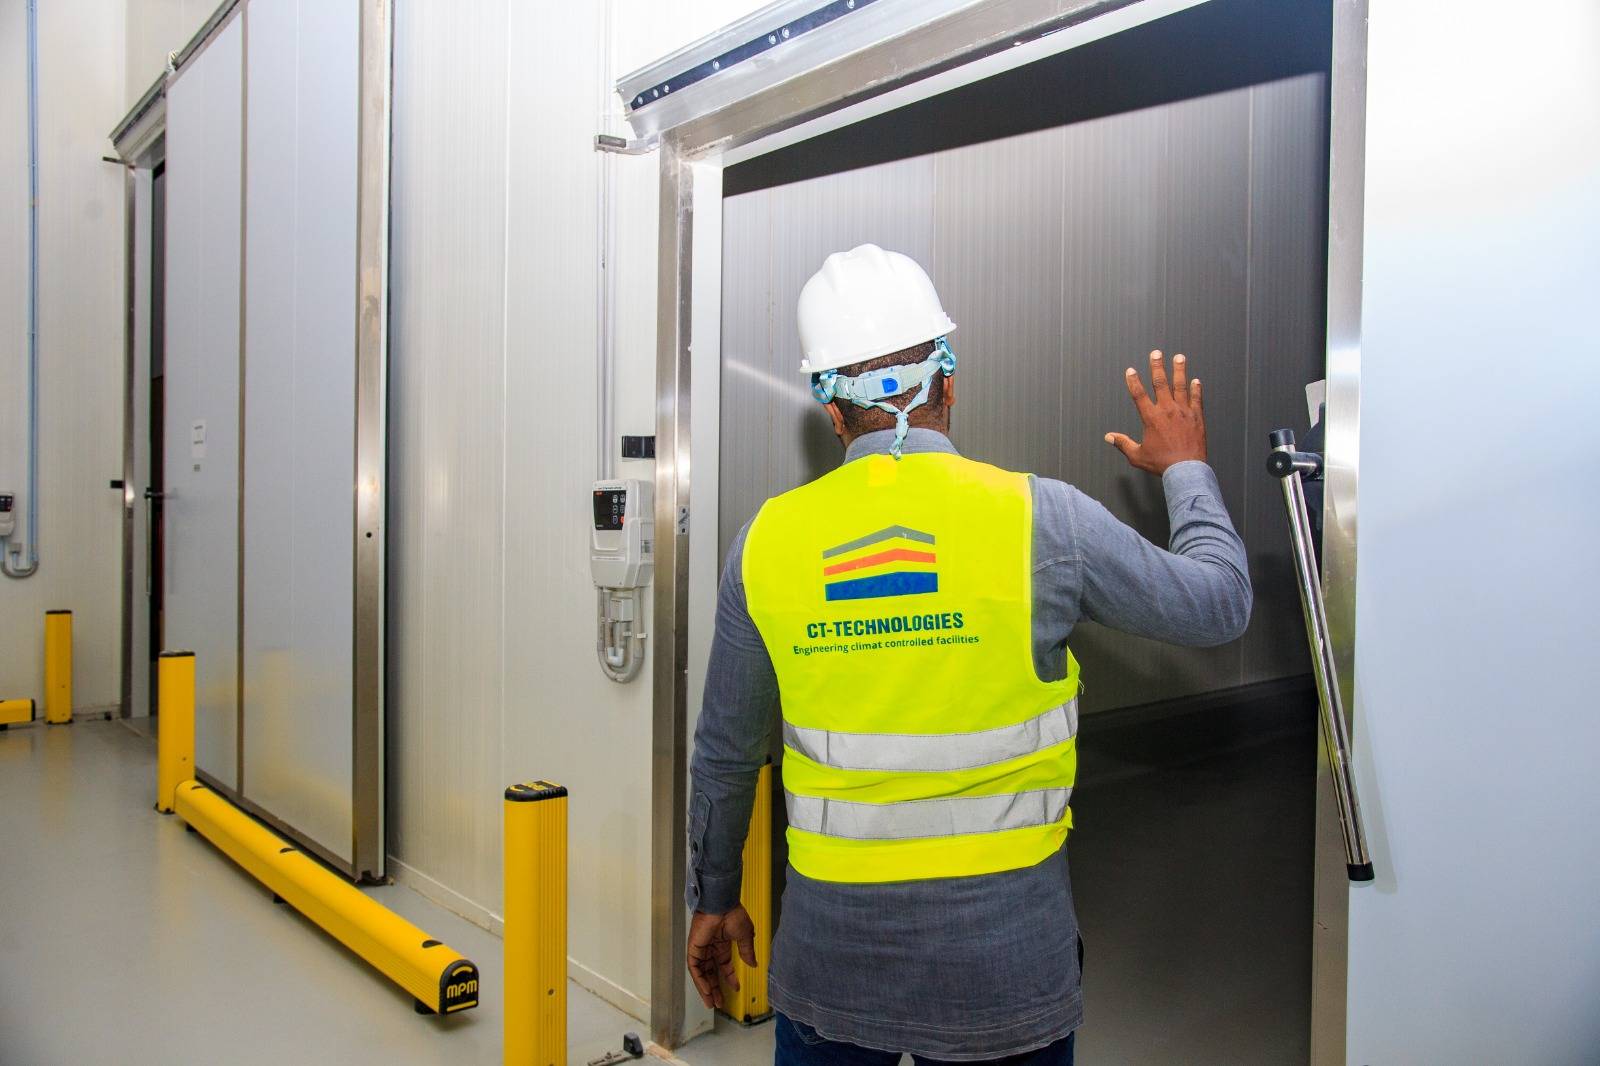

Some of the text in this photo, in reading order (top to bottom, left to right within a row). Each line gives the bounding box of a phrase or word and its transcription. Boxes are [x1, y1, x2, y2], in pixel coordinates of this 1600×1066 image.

[807, 612, 964, 639] CT-TECHNOLOGIES
[793, 634, 980, 656] Engineering climat controlled facilities
